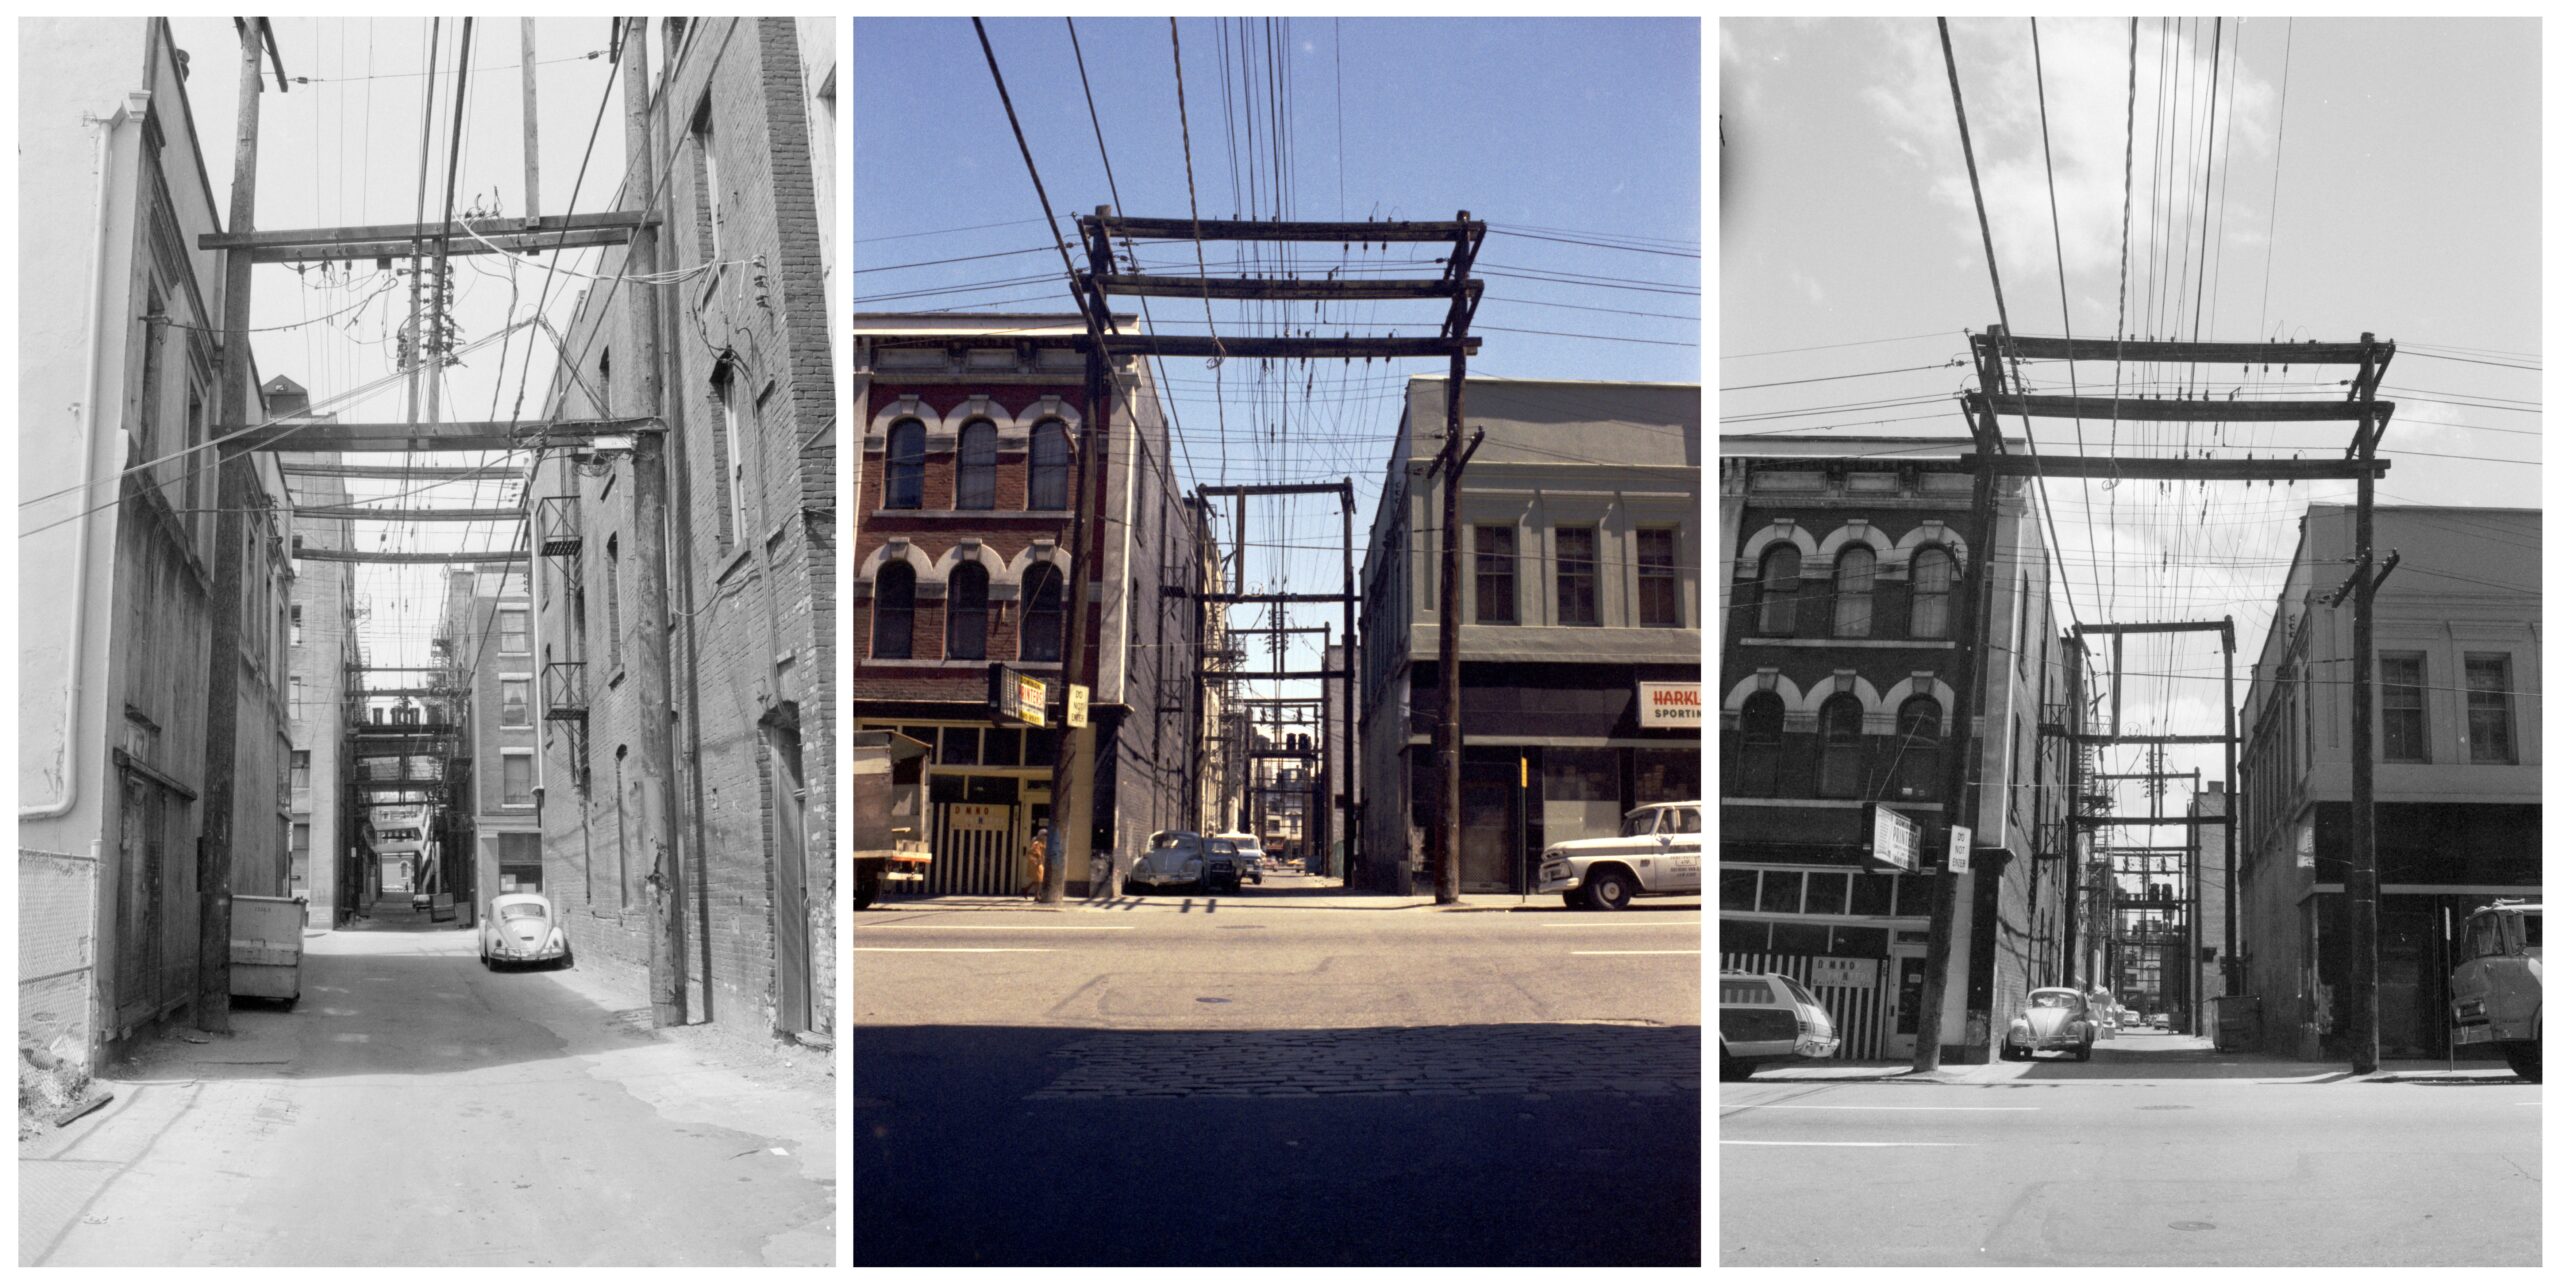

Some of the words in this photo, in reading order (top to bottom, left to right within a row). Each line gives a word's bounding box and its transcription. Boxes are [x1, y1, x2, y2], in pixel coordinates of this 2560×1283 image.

[1075, 690, 1083, 699] DO
[1653, 690, 1701, 706] HARKL
[1073, 702, 1085, 712] NOT
[1071, 713, 1085, 723] ENTER
[1893, 825, 1918, 850] PRINTERS
[1957, 832, 1965, 842] DO
[1955, 845, 1965, 855] NOT
[1952, 857, 1966, 868] ENTER
